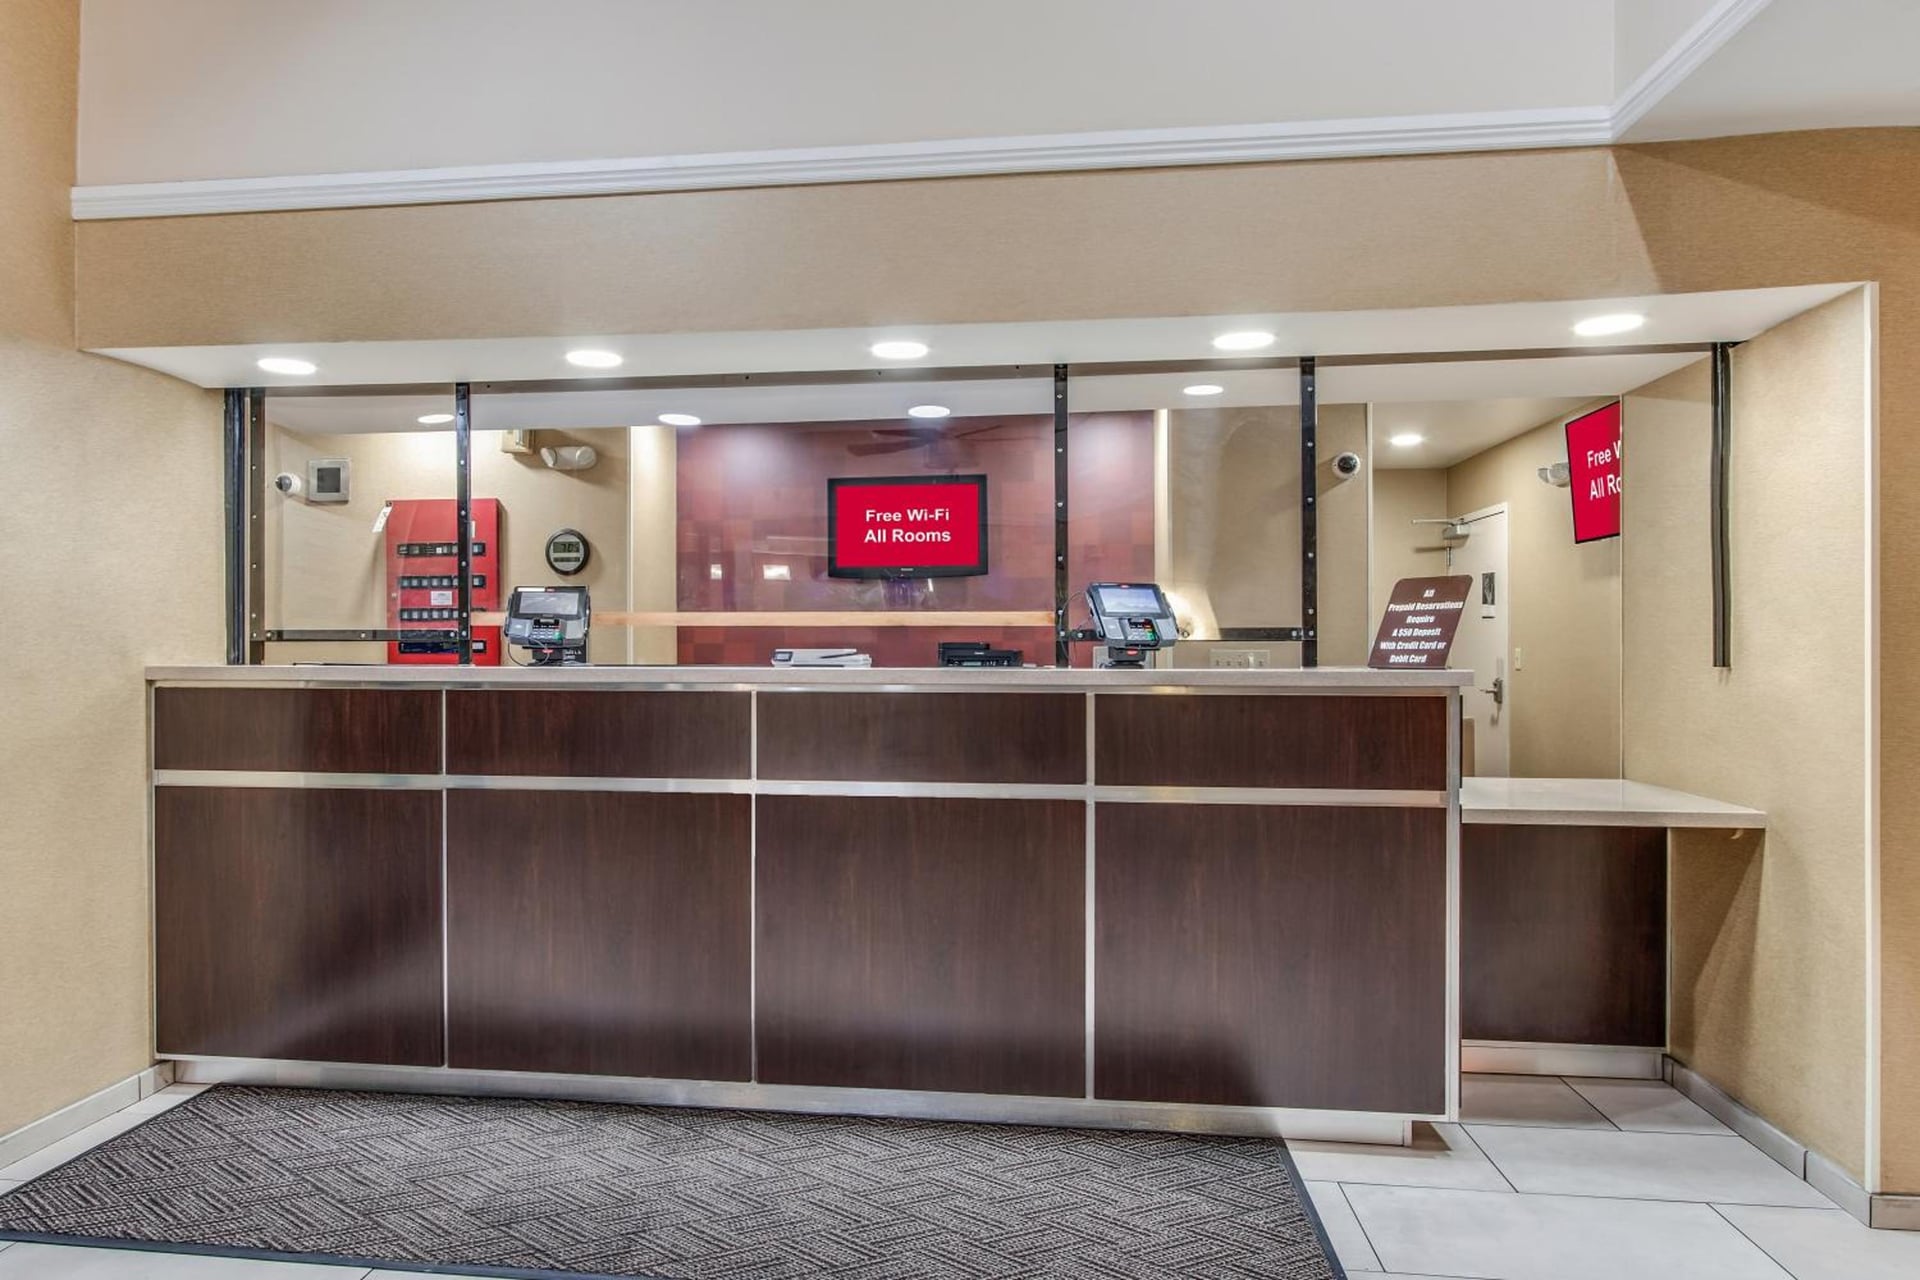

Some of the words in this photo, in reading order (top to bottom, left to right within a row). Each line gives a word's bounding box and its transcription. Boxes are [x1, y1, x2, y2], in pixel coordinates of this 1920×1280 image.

[1587, 449, 1611, 469] Free
[1590, 476, 1605, 501] All
[866, 509, 902, 522] Free
[907, 508, 950, 521] Wi-Fi
[864, 529, 887, 543] All
[892, 528, 951, 542] Rooms
[1388, 603, 1415, 612] Prepaid
[1416, 601, 1463, 610] Reservations
[1406, 615, 1435, 624] Require
[1392, 629, 1398, 637] A
[1398, 628, 1412, 637] $50
[1413, 628, 1441, 637] Deposit
[1397, 641, 1418, 649] Credit
[1419, 641, 1437, 649] Card
[1389, 655, 1408, 663] Debit
[1409, 655, 1427, 663] Card
